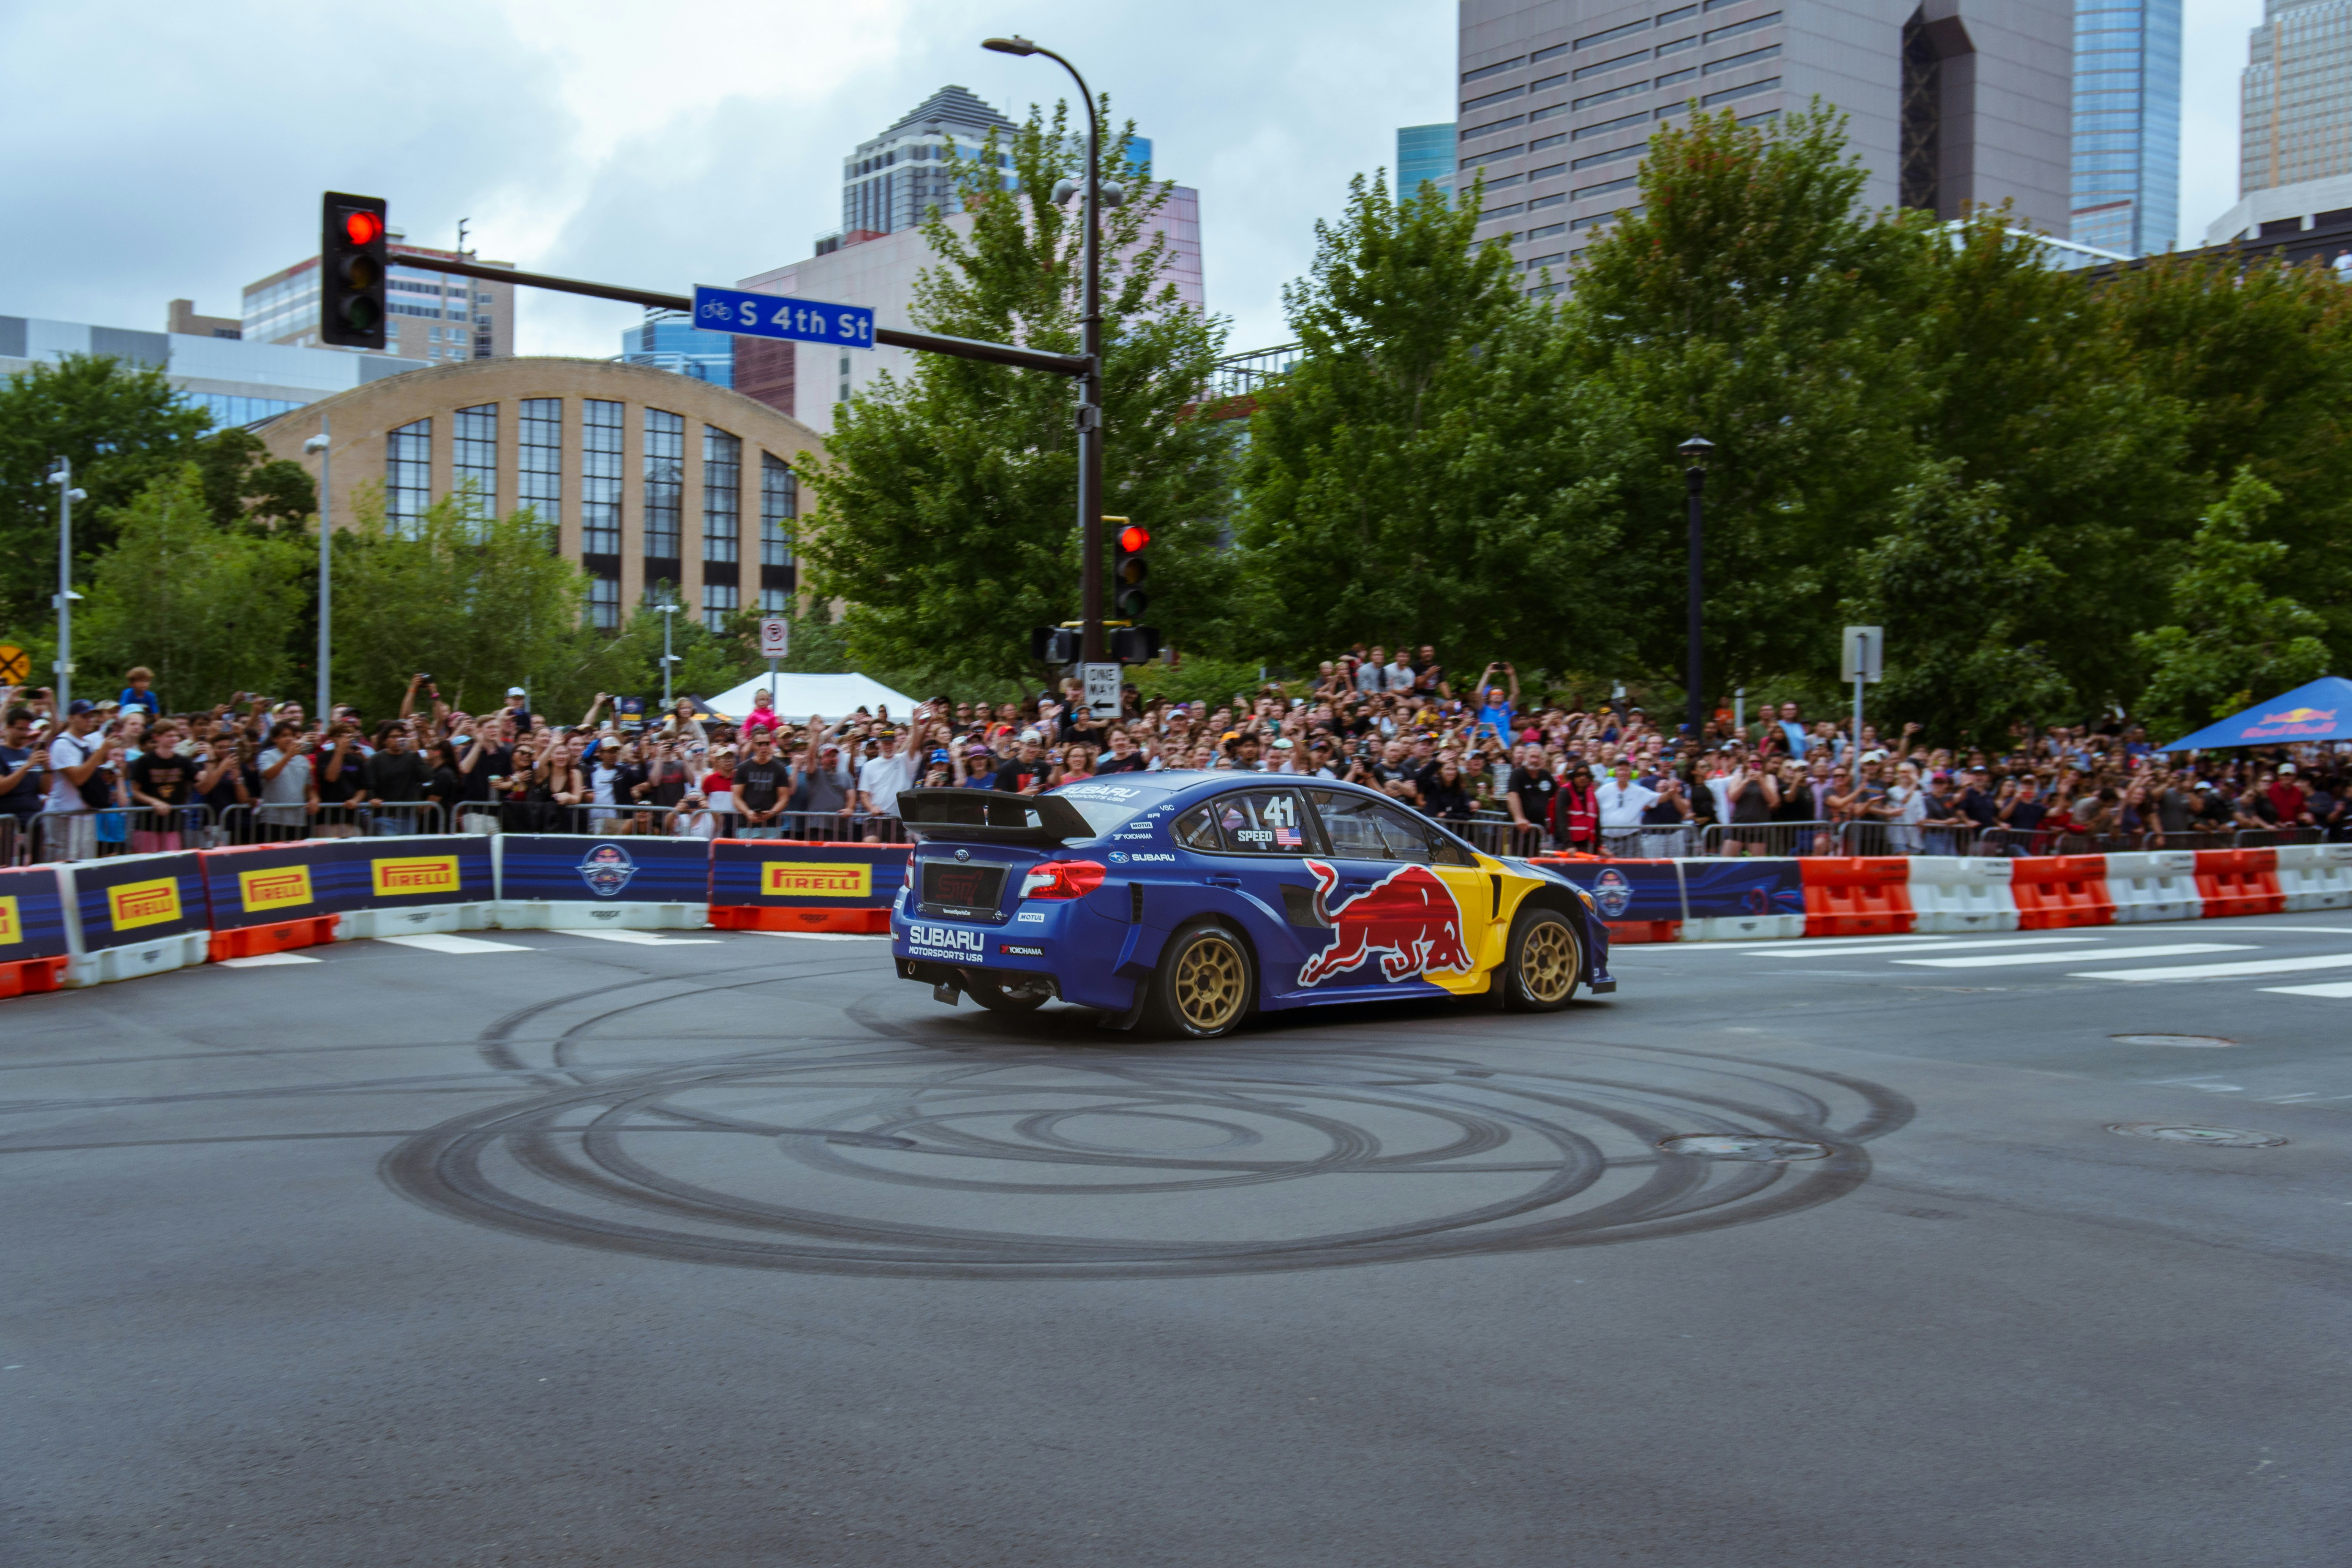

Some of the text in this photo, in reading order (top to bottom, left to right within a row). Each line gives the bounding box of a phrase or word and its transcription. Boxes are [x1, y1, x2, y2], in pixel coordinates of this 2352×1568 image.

[739, 300, 869, 340] S 4th St
[1089, 669, 1116, 681] ONE
[1088, 683, 1117, 696] WAY
[1056, 786, 1141, 798] SUBARU
[1264, 797, 1294, 826] 41
[1238, 830, 1272, 841] SPEED
[380, 863, 451, 887] PIRELLI
[772, 869, 861, 890] PIRELLI
[247, 874, 305, 903] PIRELLI
[116, 887, 174, 921] PIRELLI
[910, 926, 984, 951] SUBARU
[909, 946, 983, 963] MOTORSPORTS USA
[1009, 946, 1042, 955] YOKOHAMA
